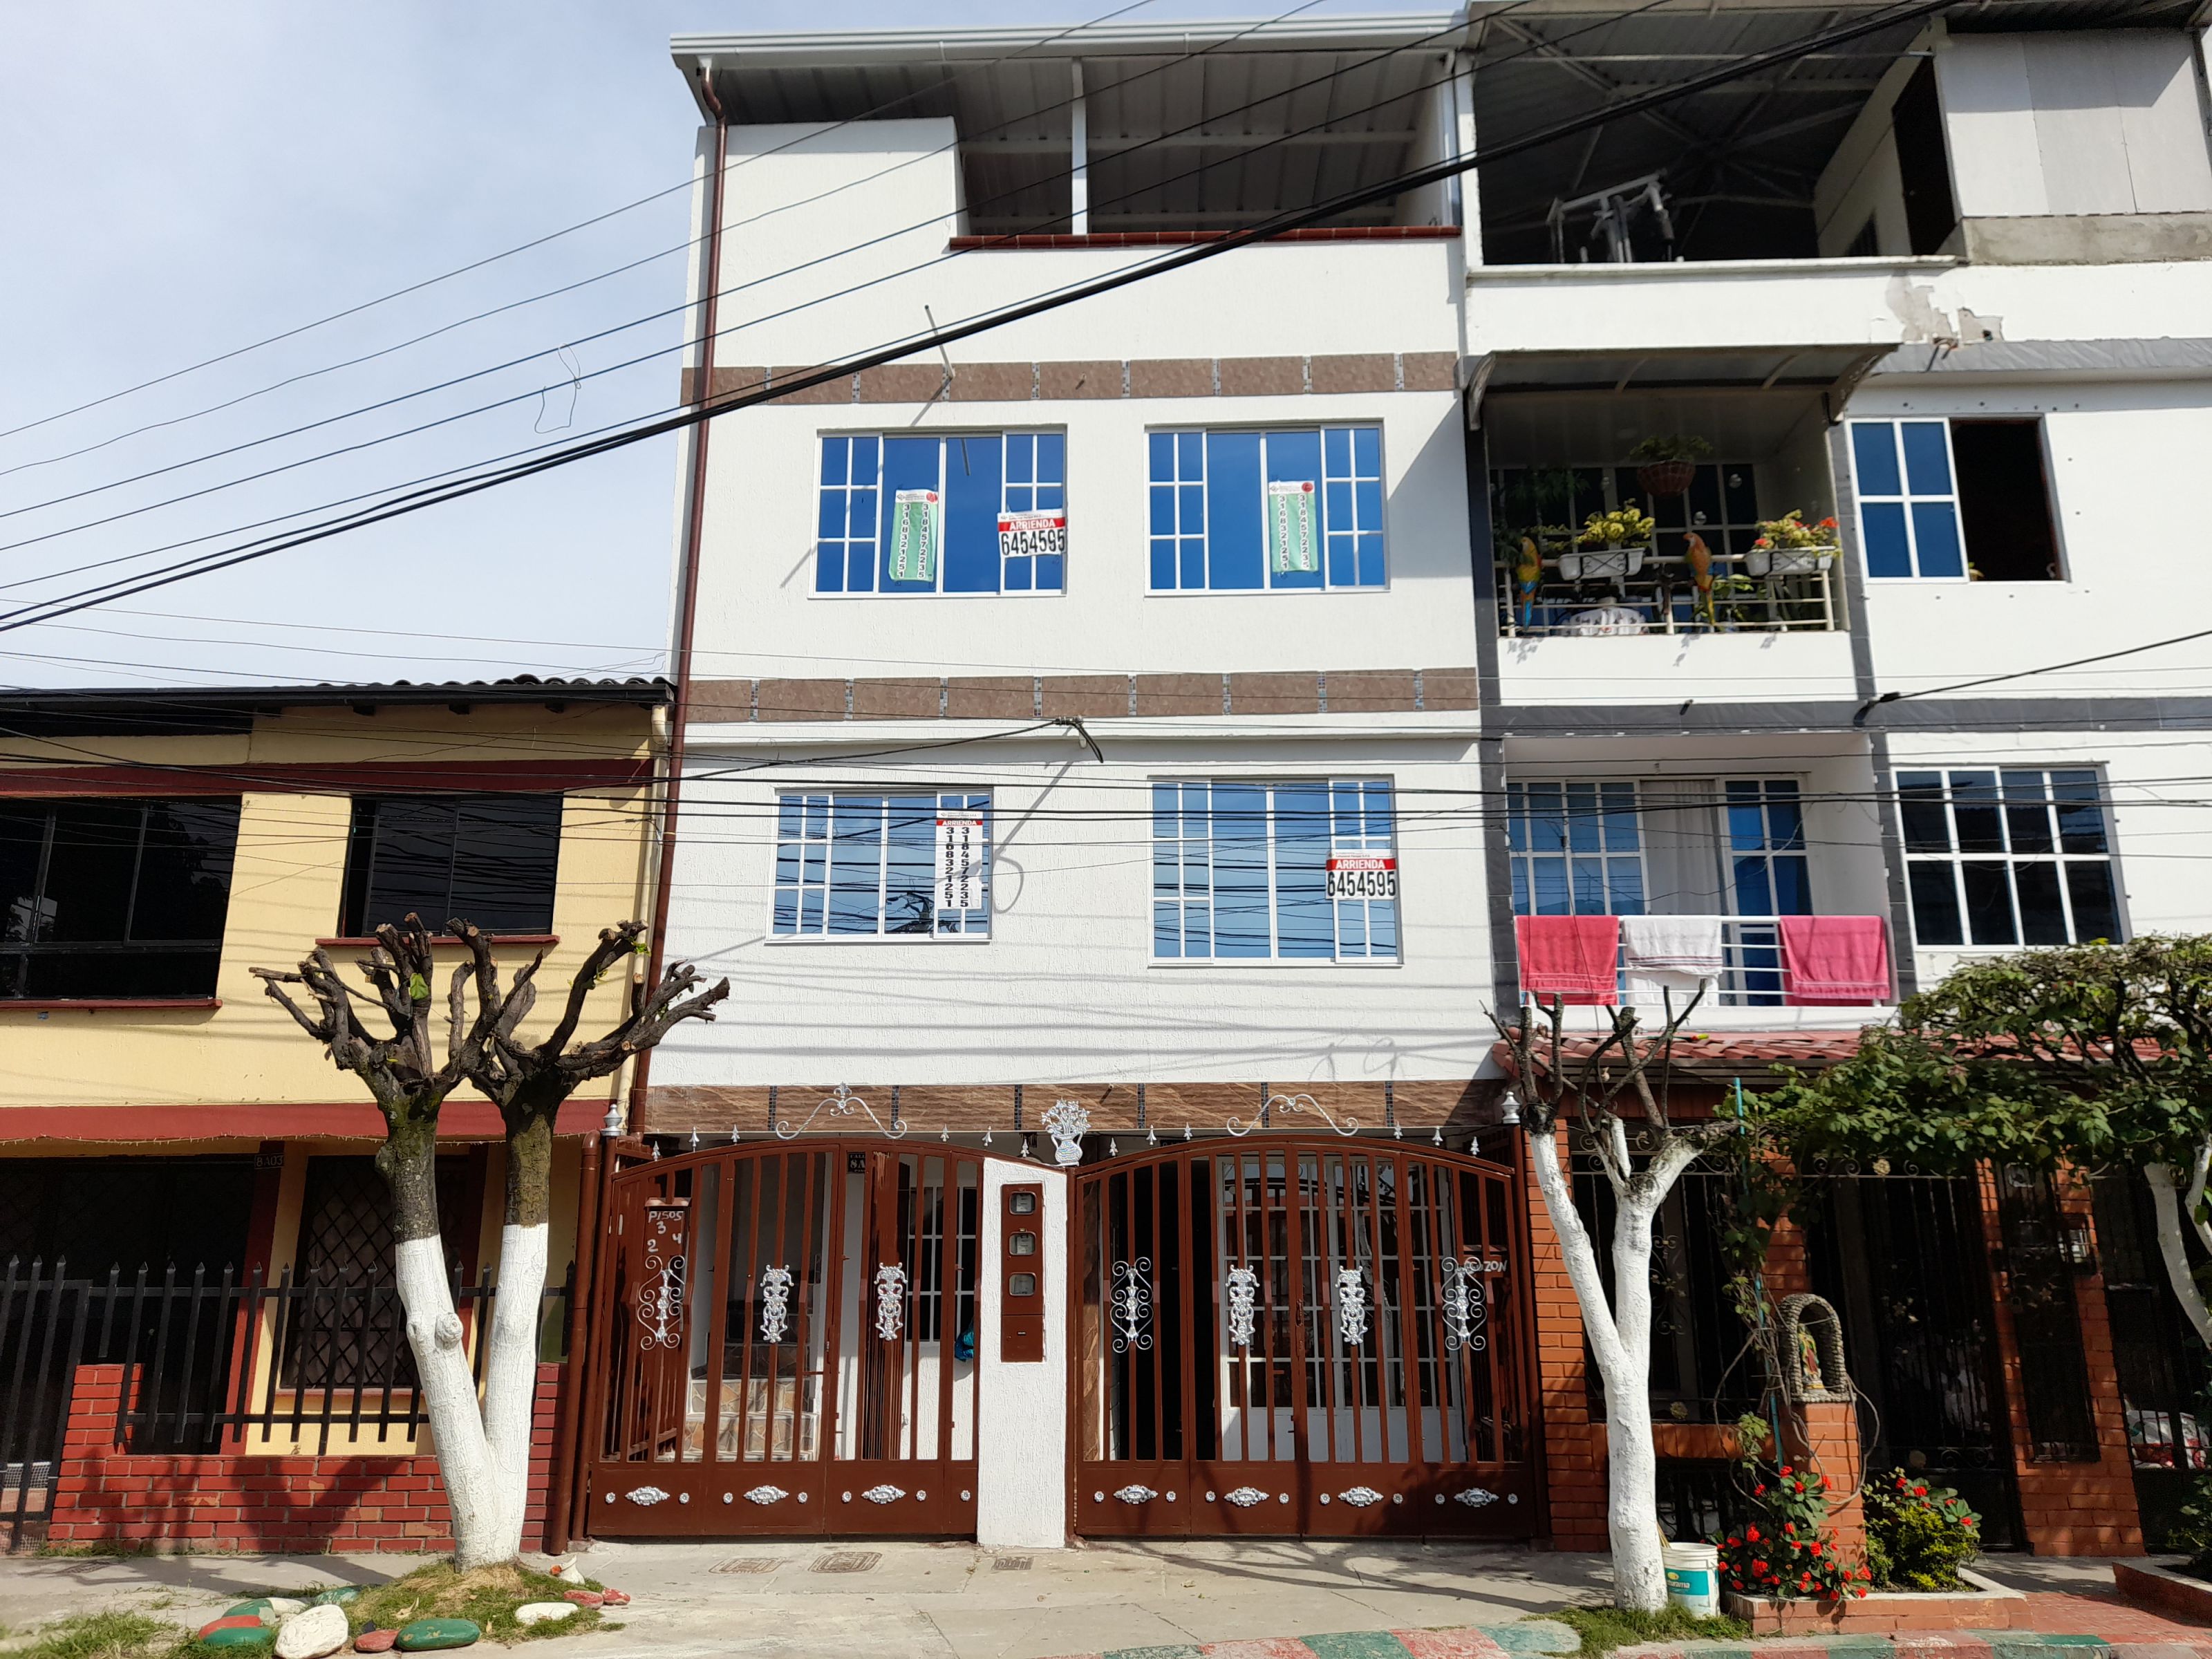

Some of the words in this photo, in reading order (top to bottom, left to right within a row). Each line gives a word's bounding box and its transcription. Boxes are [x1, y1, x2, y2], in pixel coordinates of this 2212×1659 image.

[1009, 518, 1056, 531] ARRIENDA
[918, 503, 930, 579] 3184572235
[1001, 529, 1065, 556] 6454595
[944, 827, 955, 907] 3168321251
[959, 827, 970, 907] 3184572235
[1335, 859, 1386, 870] ARRIENDA
[1327, 871, 1396, 897] 6454595
[648, 1210, 684, 1223] PISOS
[656, 1221, 666, 1234] 3
[672, 1232, 682, 1244] 4
[647, 1239, 658, 1253] 2
[1465, 1259, 1508, 1274] ZON
